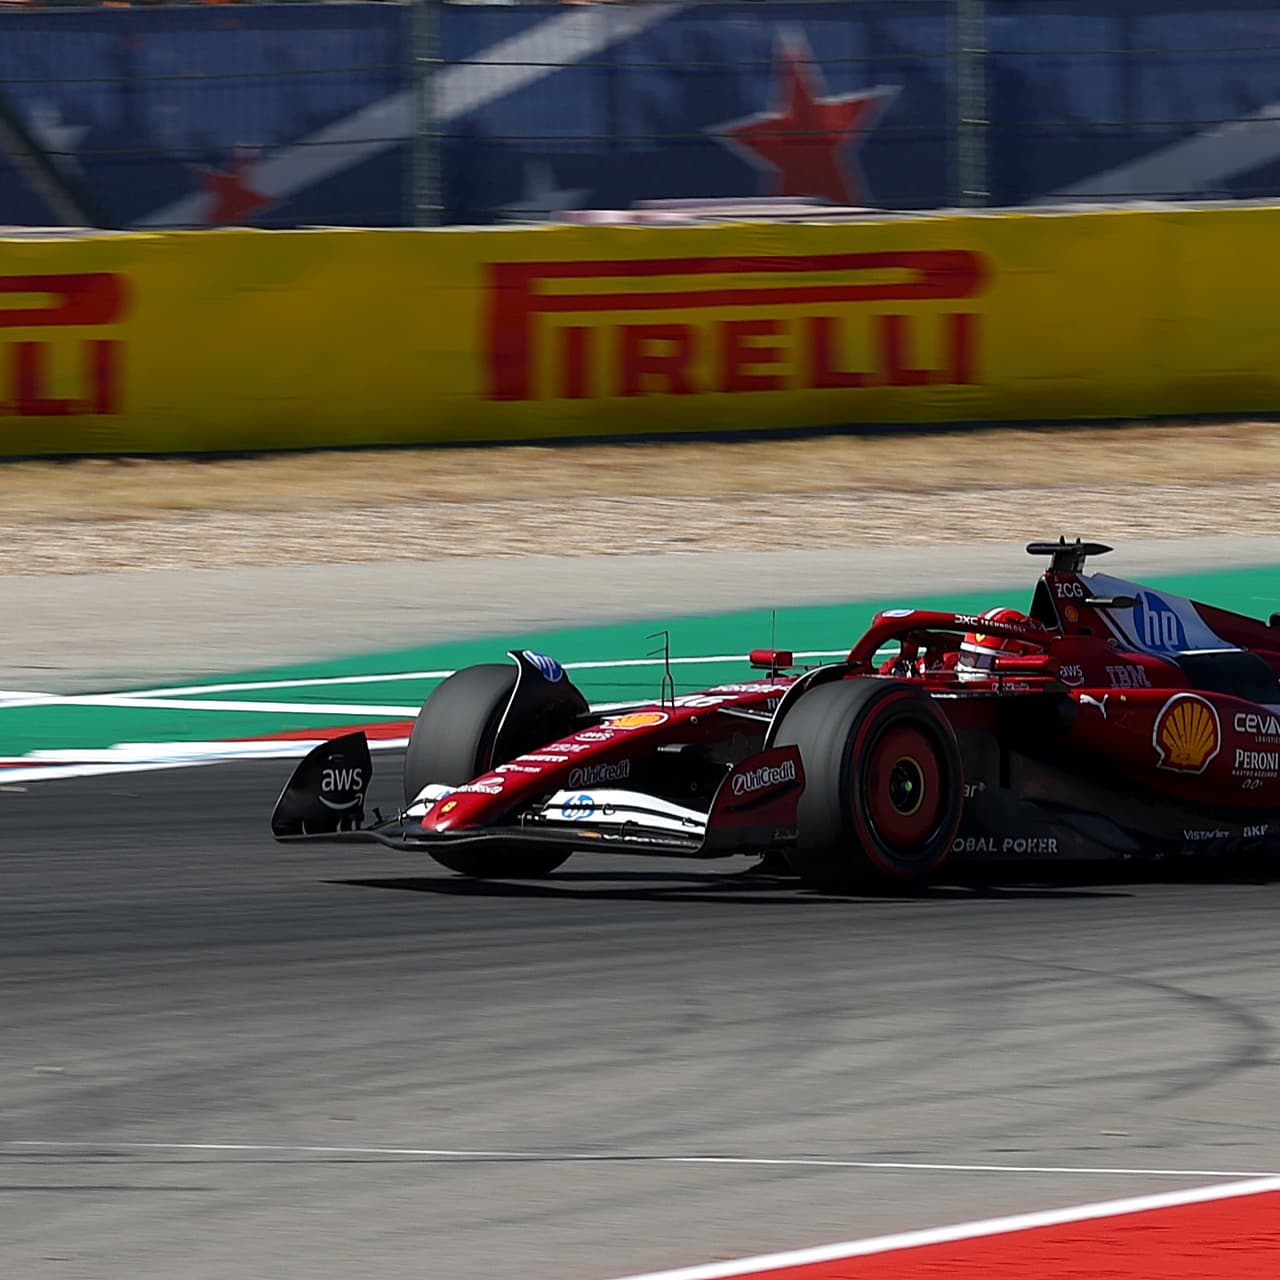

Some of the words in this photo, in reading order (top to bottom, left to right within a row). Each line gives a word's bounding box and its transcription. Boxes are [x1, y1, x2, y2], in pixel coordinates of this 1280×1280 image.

[482, 249, 994, 402] PIRELLI
[1055, 583, 1084, 598] ZCG
[1139, 591, 1180, 652] hp
[1105, 665, 1152, 688] IBM
[1234, 748, 1279, 770] PERONI
[321, 768, 363, 792] aws
[742, 759, 796, 792] UniCredit
[952, 837, 998, 853] OBAL
[1001, 837, 1058, 853] POKER
